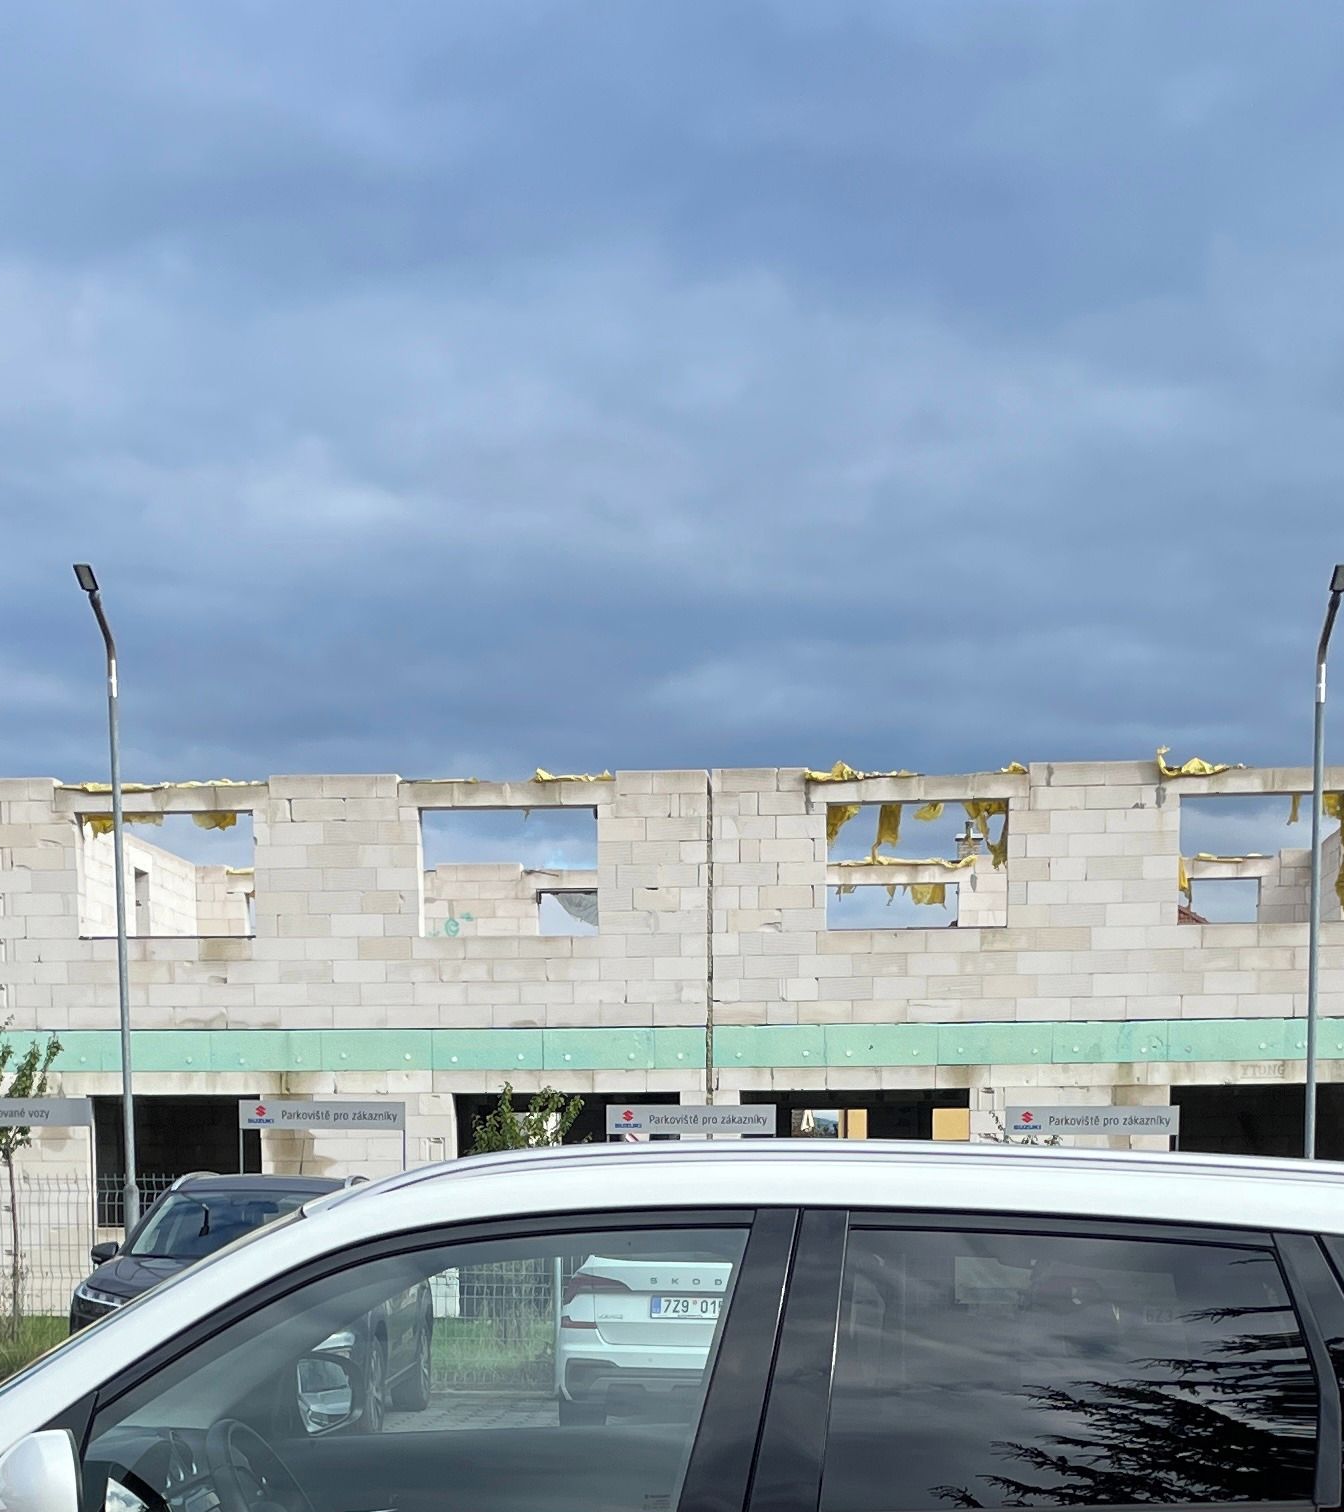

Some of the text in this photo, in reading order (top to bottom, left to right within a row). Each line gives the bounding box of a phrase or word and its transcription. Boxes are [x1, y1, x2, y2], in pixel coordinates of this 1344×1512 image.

[28, 1110, 50, 1120] vozy
[281, 1109, 398, 1123] Parkoviště pro zákazníky
[649, 1114, 768, 1126] Parkoviště pro zákazníky
[1049, 1115, 1170, 1127] Parkoviště pro zákazníky
[650, 1277, 723, 1286] SKOD
[663, 1299, 689, 1313] 7Z9
